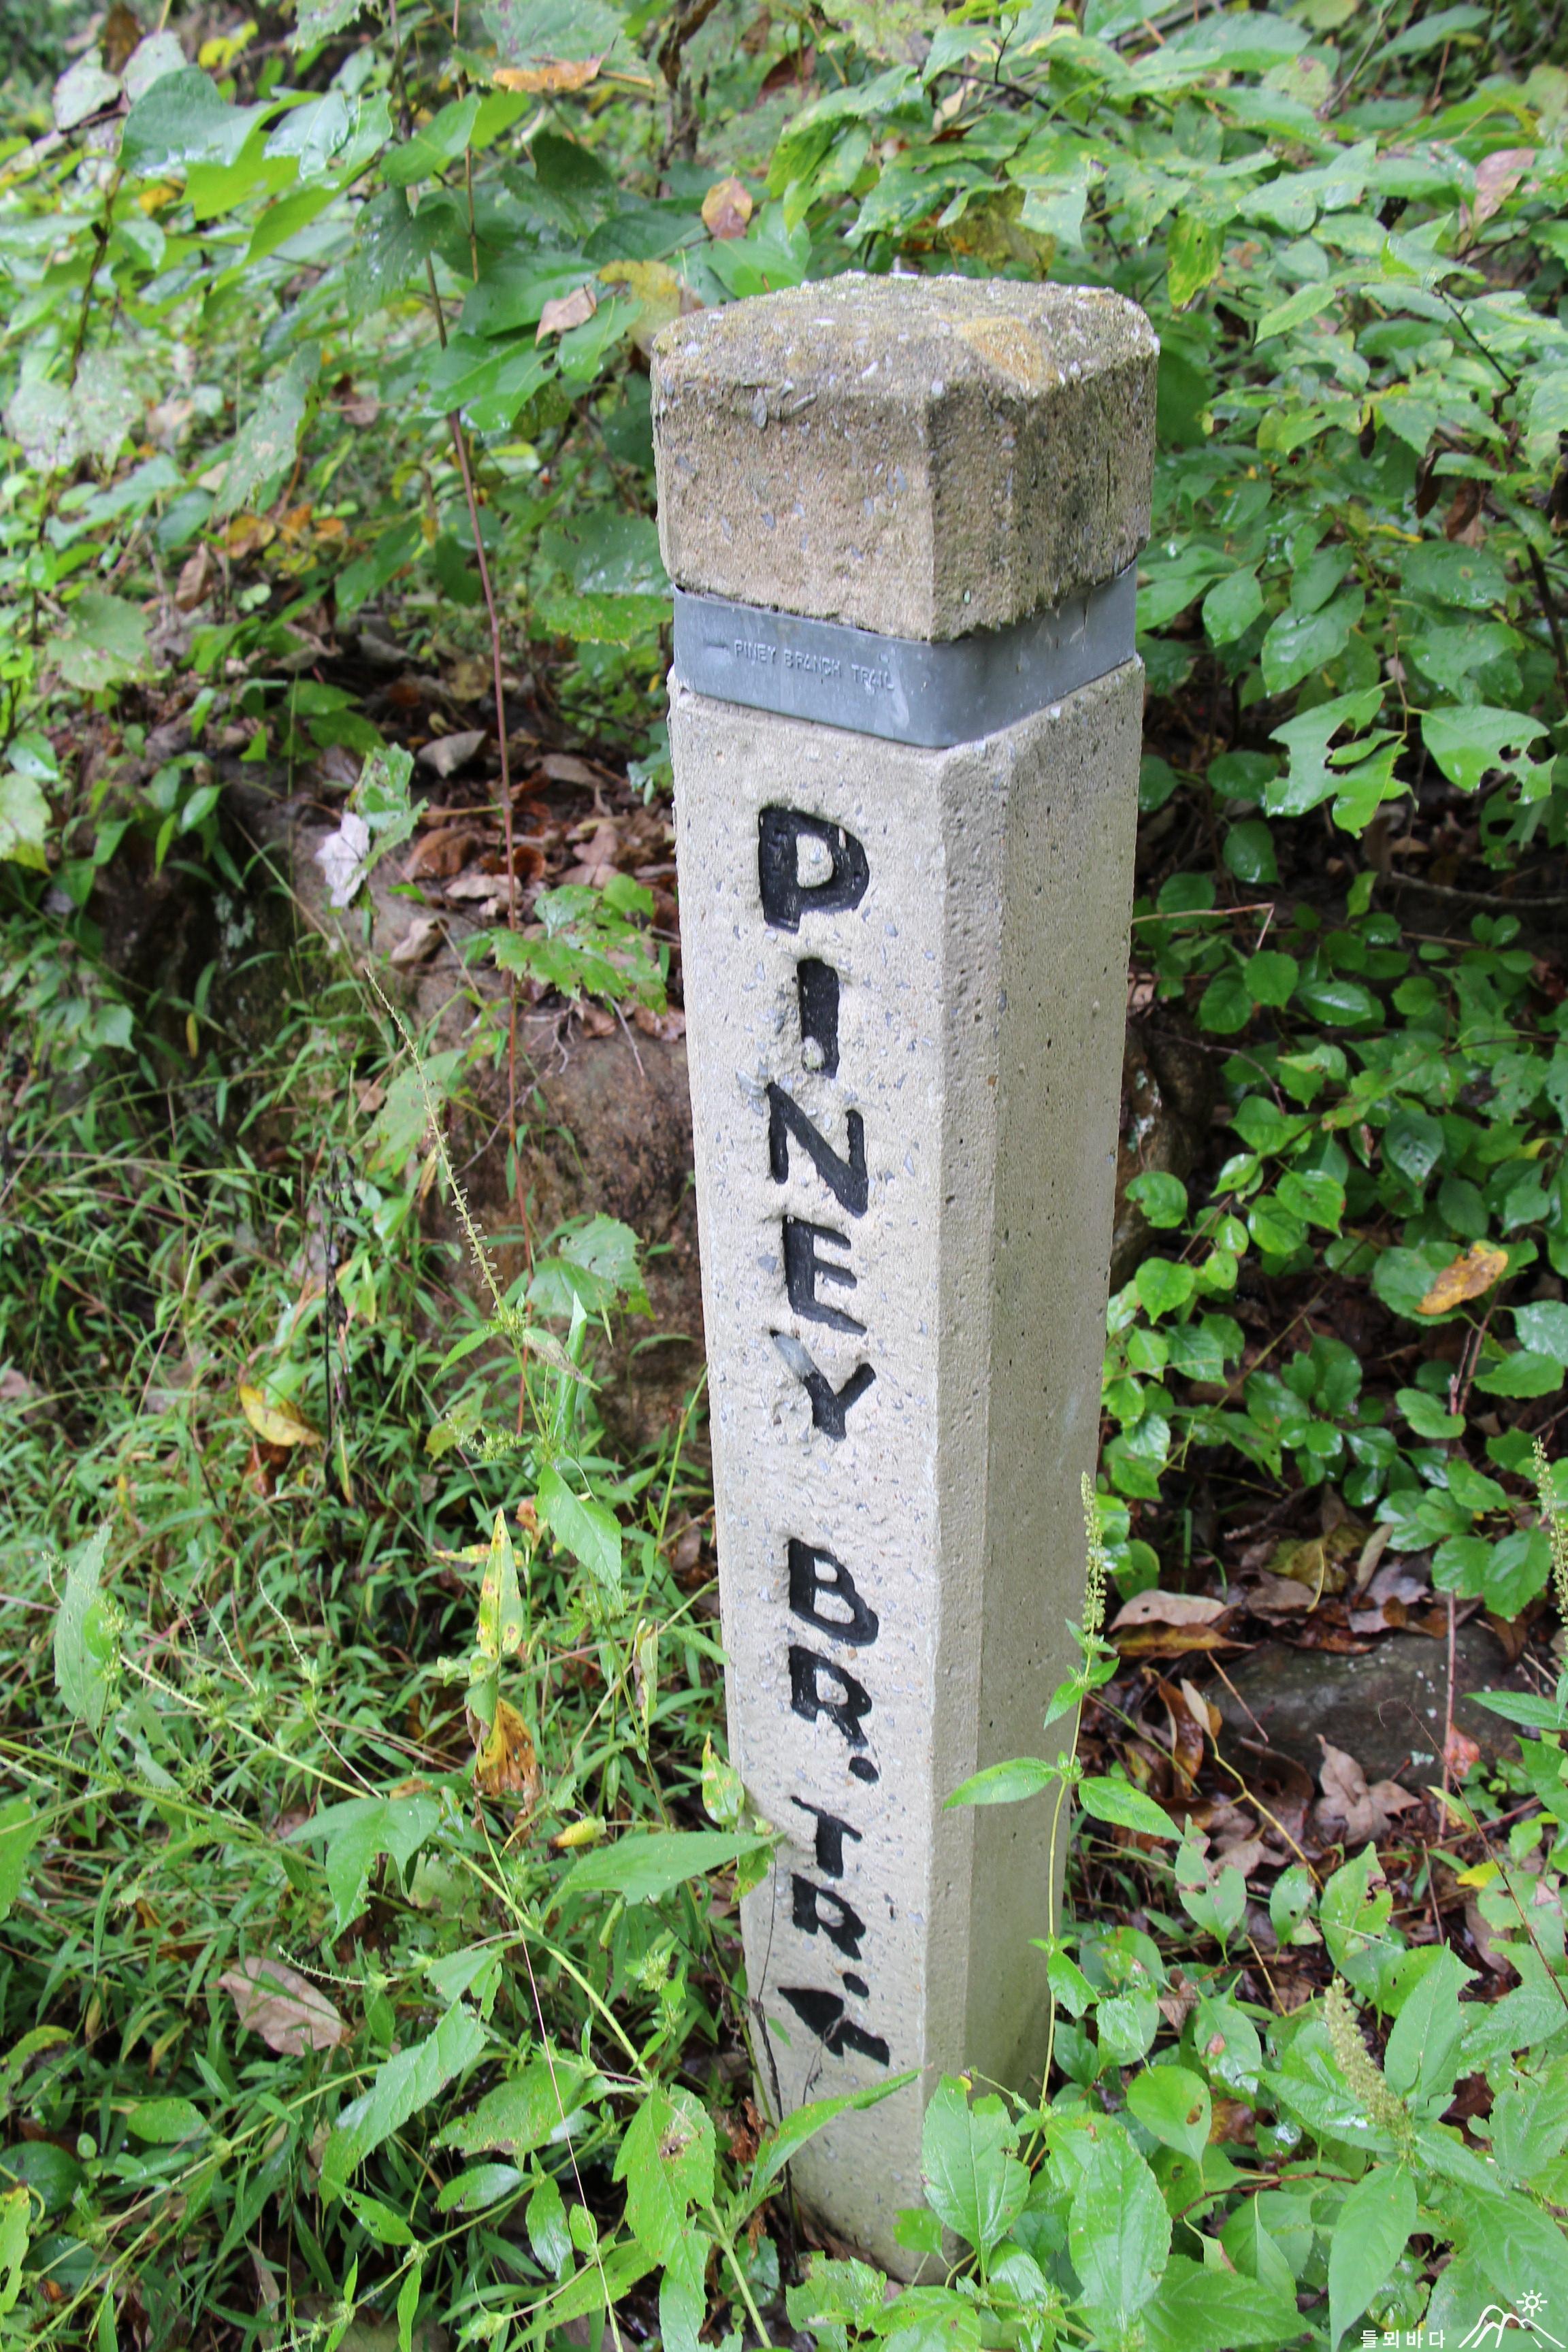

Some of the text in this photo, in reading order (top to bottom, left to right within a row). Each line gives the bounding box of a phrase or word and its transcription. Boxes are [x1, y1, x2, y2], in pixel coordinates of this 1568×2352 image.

[734, 639, 895, 690] PINEY BRANCH TRAIL
[758, 804, 879, 1999] PINEY BR. TR.
